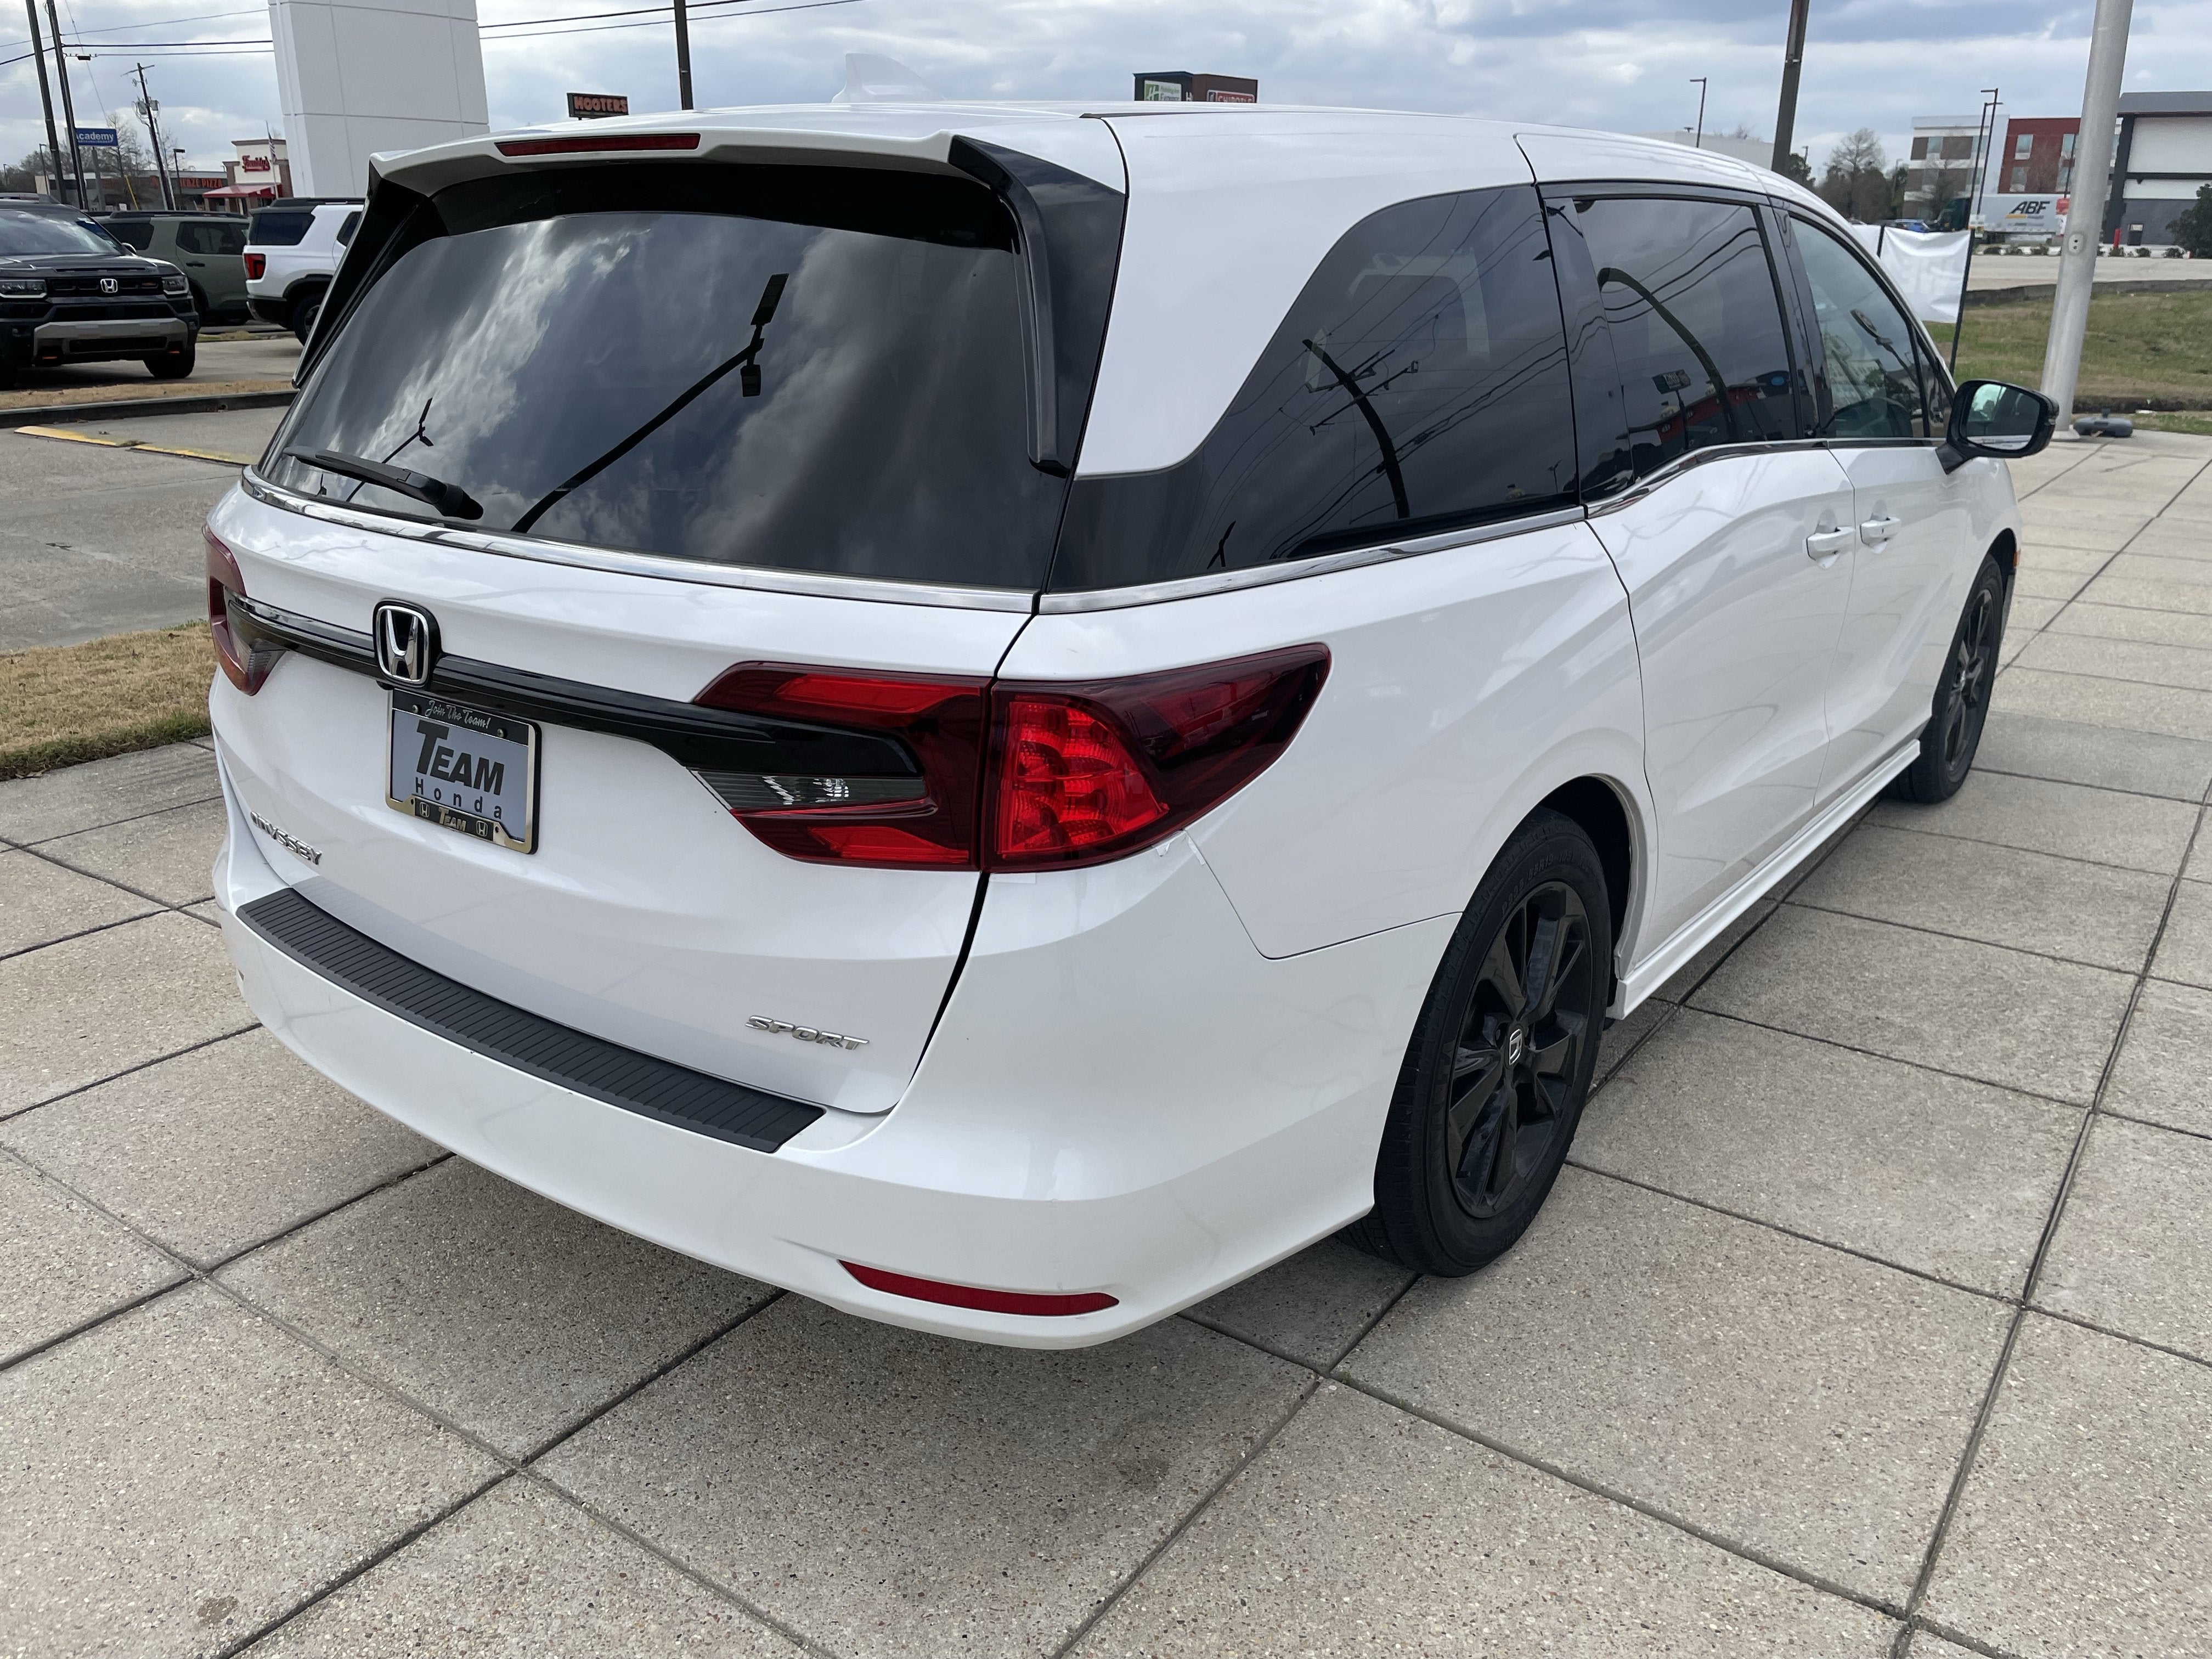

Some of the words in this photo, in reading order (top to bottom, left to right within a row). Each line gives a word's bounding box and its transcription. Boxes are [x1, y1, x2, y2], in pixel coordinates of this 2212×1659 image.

[574, 96, 627, 112] HOOTERS
[202, 179, 223, 188] PIZZA
[2009, 200, 2050, 214] ABF
[425, 700, 445, 716] Join
[446, 705, 462, 721] The
[463, 709, 491, 729] Team!
[745, 1014, 870, 1050] SPORT
